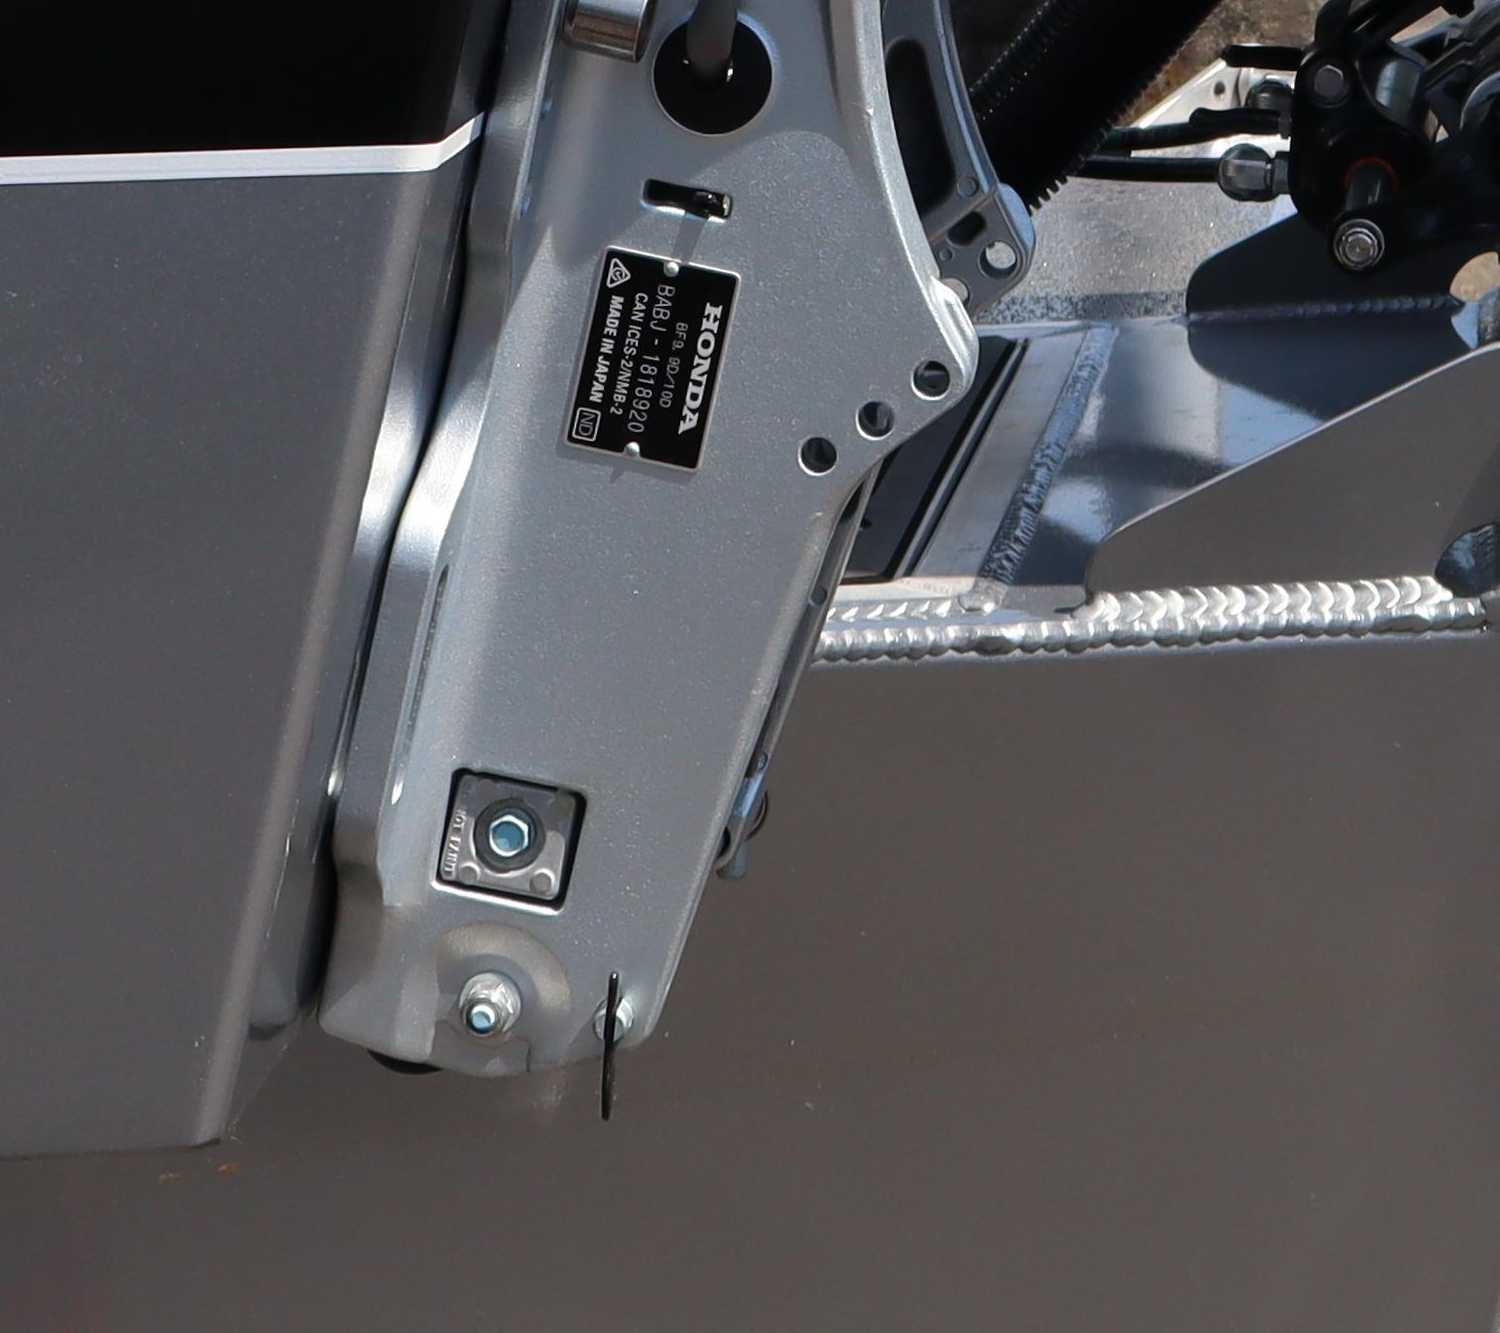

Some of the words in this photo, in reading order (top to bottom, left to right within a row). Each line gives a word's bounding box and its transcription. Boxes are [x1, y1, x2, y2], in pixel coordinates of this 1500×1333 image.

[603, 295, 624, 337] MADE
[628, 292, 648, 322] CAN
[650, 284, 676, 333] BABJ
[601, 338, 615, 353] IN
[589, 357, 611, 402] JAPAN
[610, 324, 641, 416] ICES-2/NMB-2
[678, 302, 723, 435] HONDA
[629, 355, 660, 433] 1818920
[578, 412, 595, 437] ND
